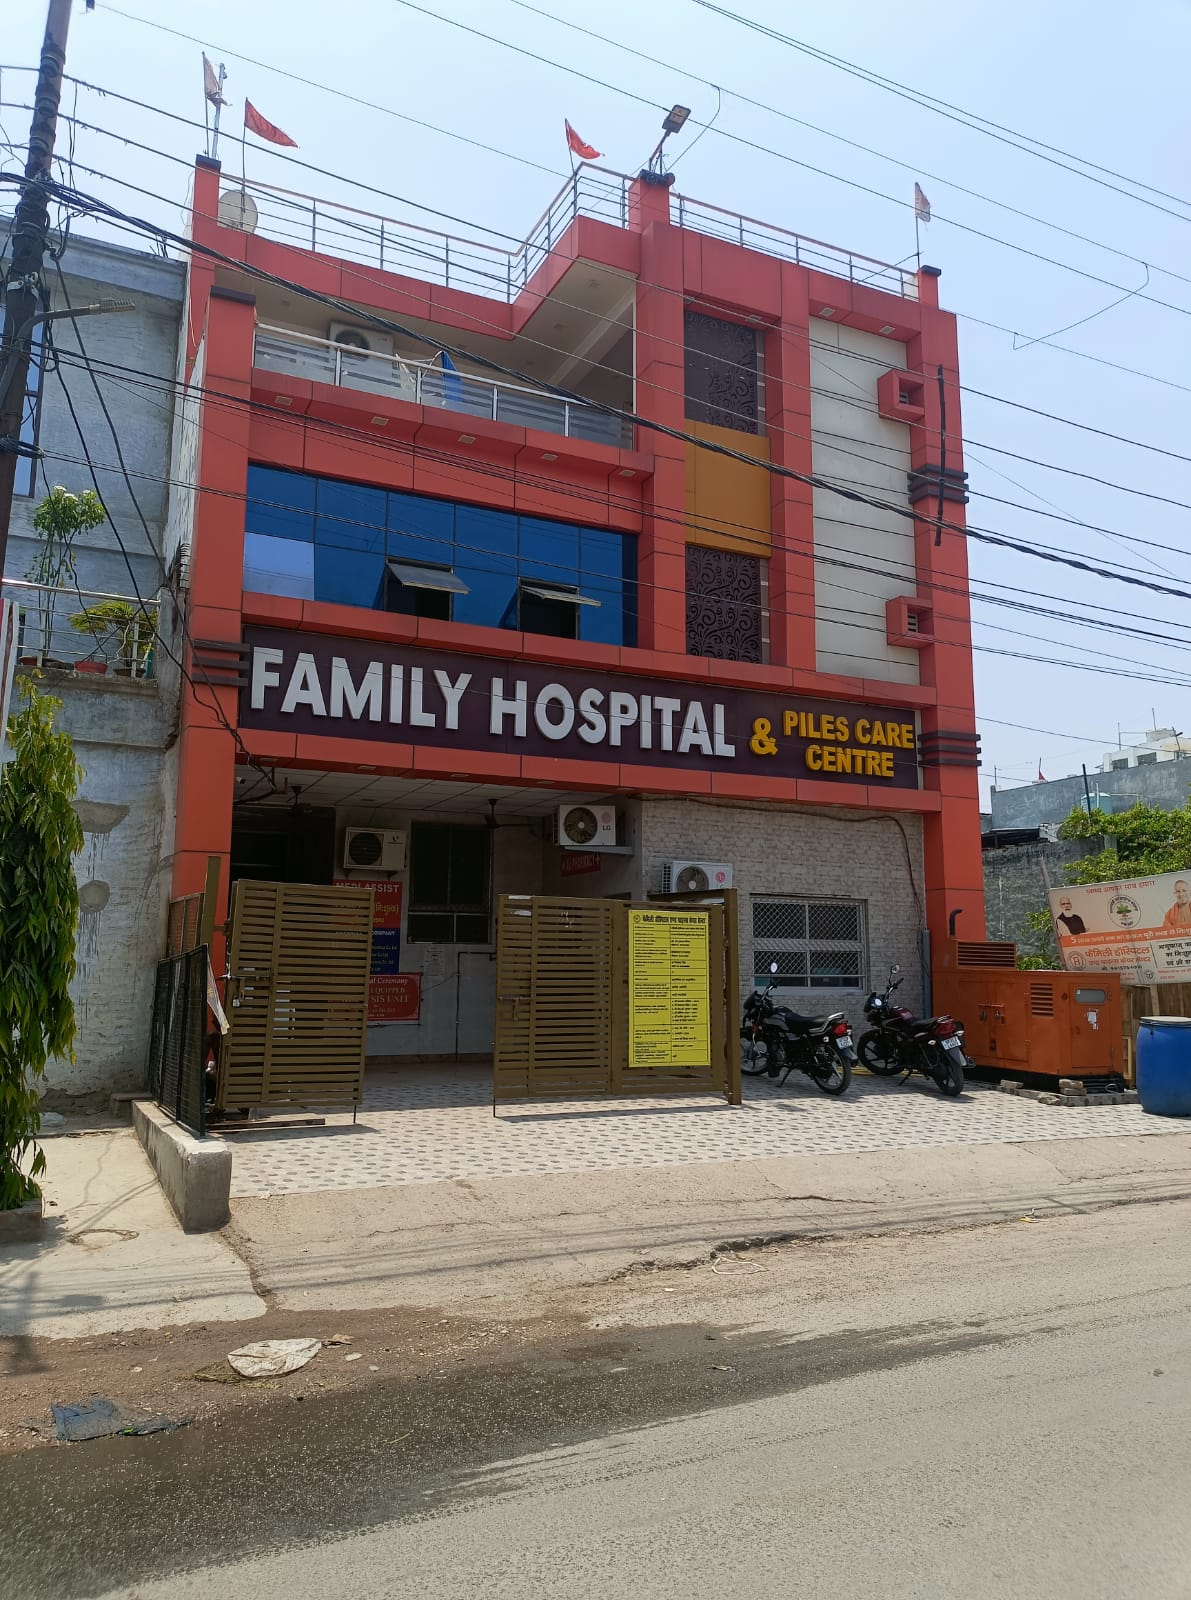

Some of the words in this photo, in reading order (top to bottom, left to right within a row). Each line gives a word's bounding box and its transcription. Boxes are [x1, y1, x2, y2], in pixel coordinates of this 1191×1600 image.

[251, 646, 473, 730] FAMILY
[489, 676, 737, 758] HOSPITAL
[750, 717, 778, 756] &
[783, 710, 850, 742] PILES
[854, 718, 915, 749] CARE
[805, 744, 895, 777] CENTRE
[365, 883, 400, 893] ASSIST
[1071, 936, 1077, 944] 5
